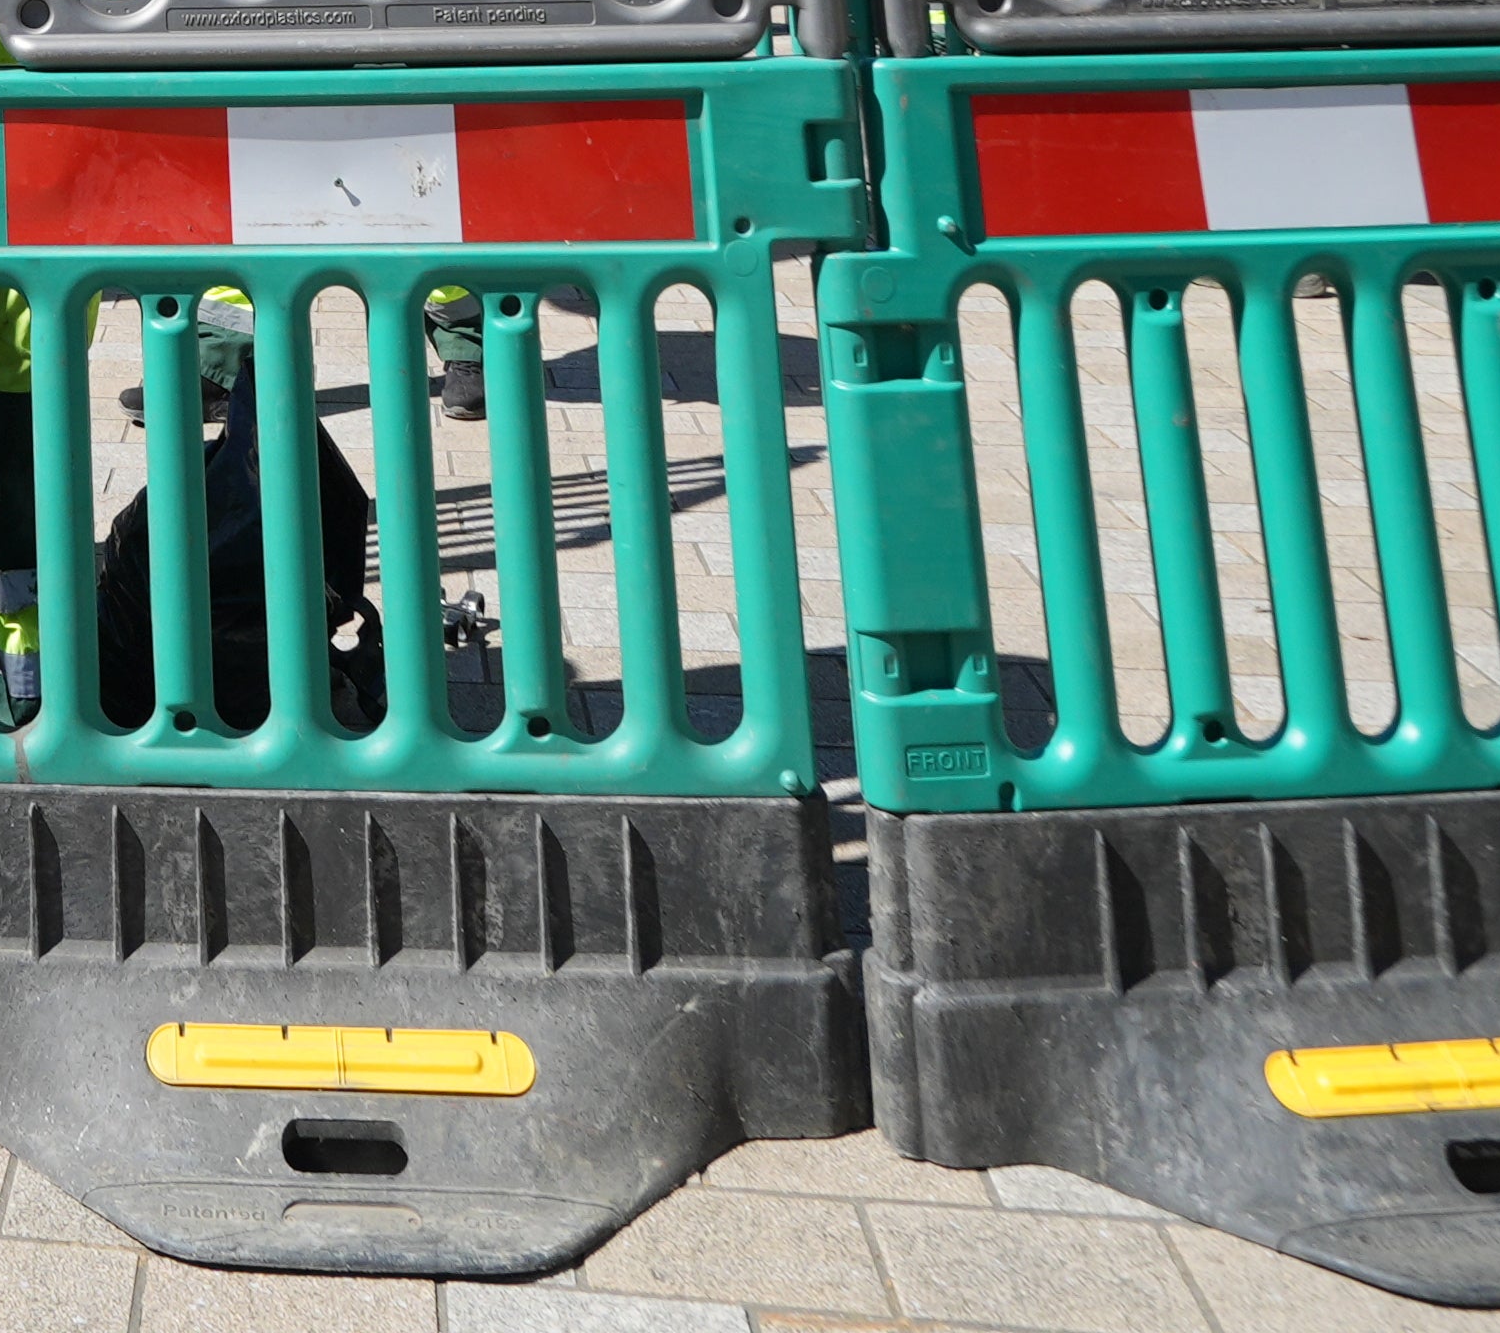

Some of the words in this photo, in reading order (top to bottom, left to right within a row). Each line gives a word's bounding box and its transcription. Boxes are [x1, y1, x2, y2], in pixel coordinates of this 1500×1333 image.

[181, 8, 357, 28] www.oxfordplastics.com
[432, 6, 482, 23] Patent
[487, 5, 546, 25] pending
[906, 749, 985, 772] FRONT
[162, 1203, 267, 1222] Patented
